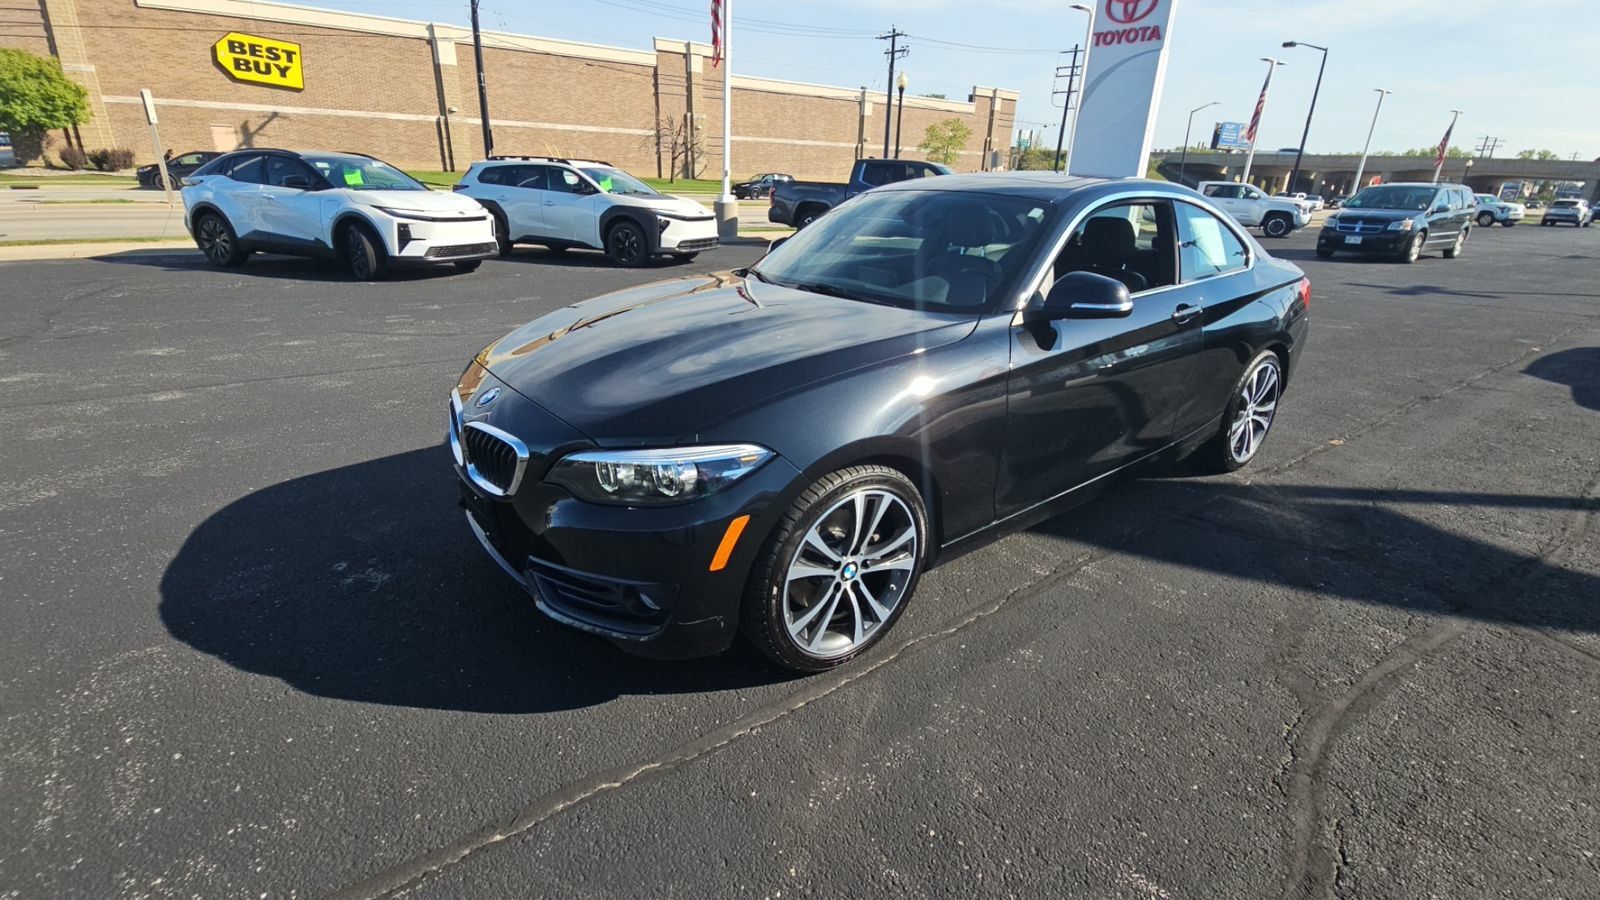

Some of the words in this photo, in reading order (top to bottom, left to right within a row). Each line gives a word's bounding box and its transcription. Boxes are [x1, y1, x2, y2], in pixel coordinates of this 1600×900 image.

[1093, 25, 1162, 47] TOYOTA
[227, 39, 297, 64] BEST
[233, 57, 292, 78] BUY
